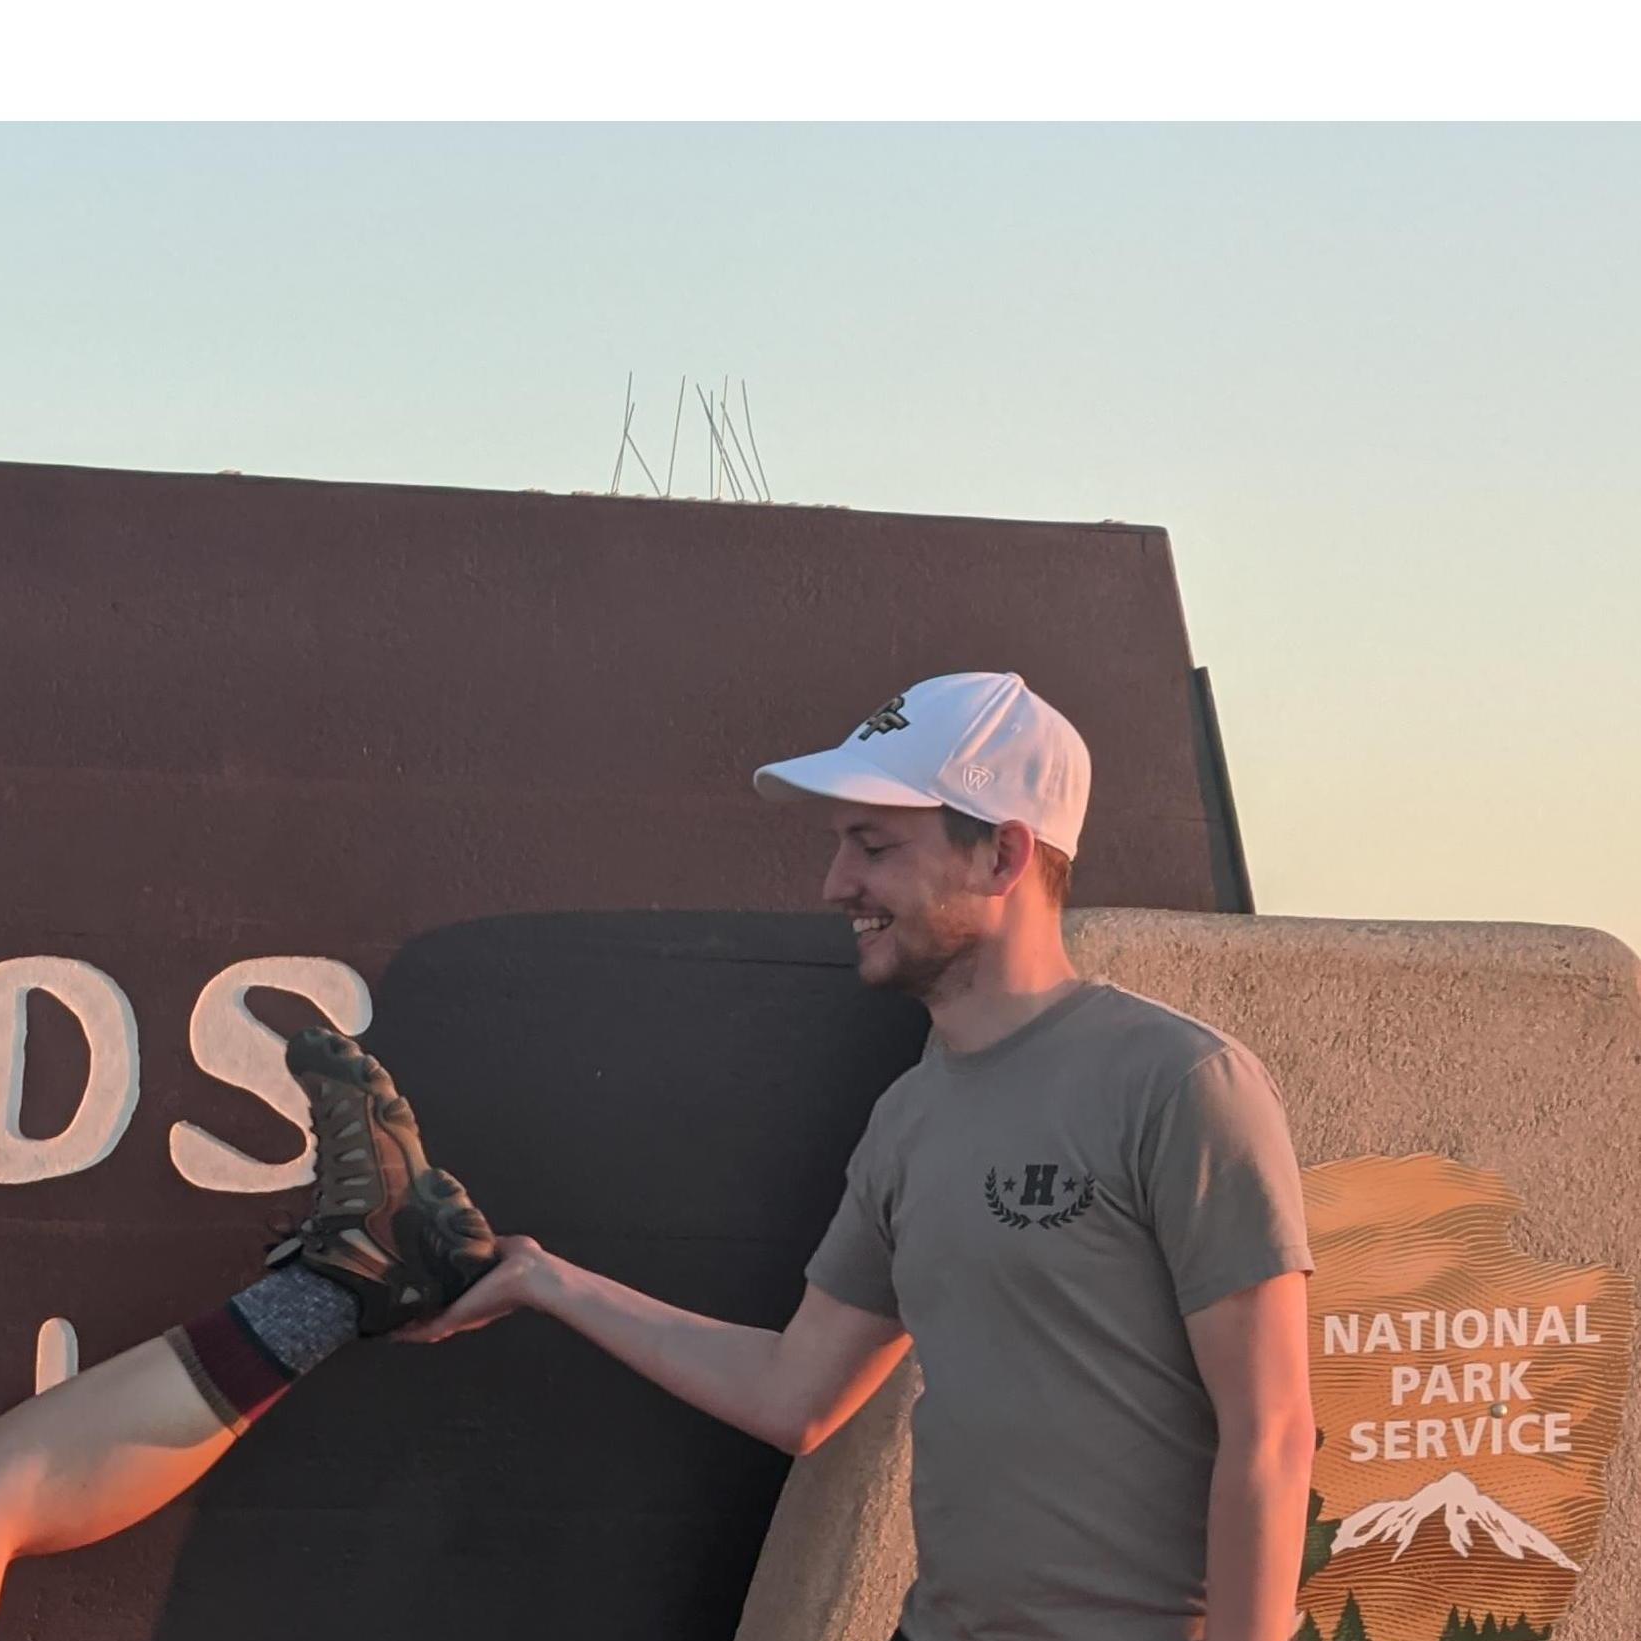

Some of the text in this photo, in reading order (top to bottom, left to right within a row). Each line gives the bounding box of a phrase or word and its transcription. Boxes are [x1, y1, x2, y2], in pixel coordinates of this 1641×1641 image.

[1019, 1164, 1058, 1206] H
[1324, 1305, 1600, 1355] NATIONAL
[1391, 1361, 1533, 1405] PARK
[1350, 1413, 1572, 1462] SERVICE
